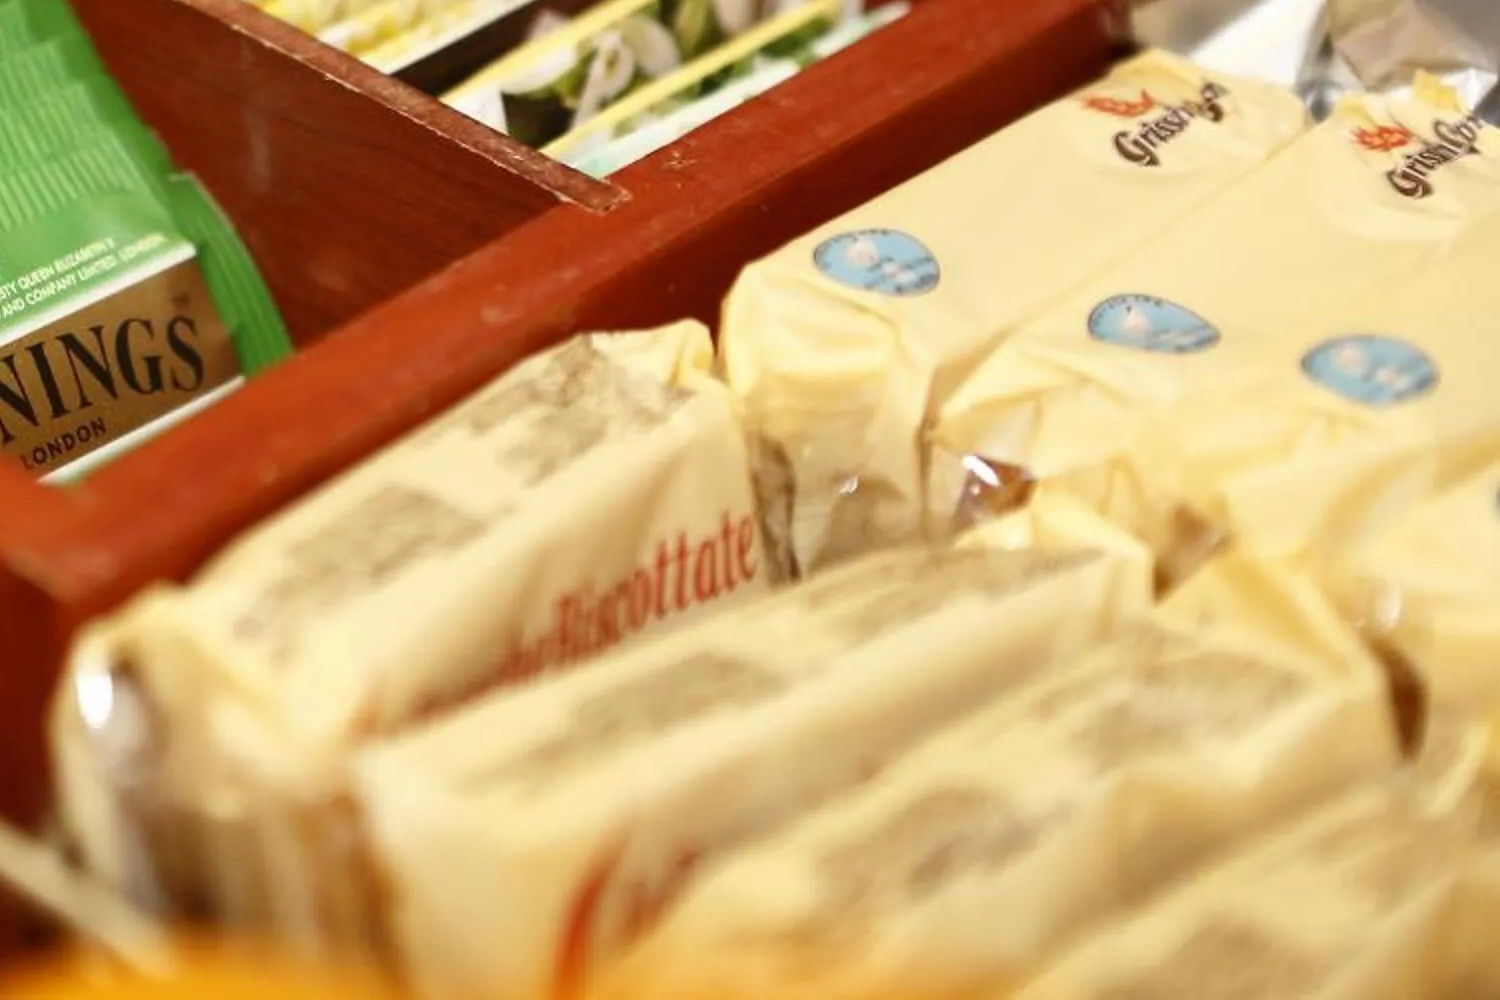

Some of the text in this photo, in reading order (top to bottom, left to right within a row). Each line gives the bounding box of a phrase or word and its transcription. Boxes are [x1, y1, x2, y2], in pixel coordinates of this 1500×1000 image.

[1, 297, 26, 319] AND
[25, 272, 78, 306] COMPANY
[17, 265, 55, 290] QUEEN
[20, 416, 107, 470] LONDON
